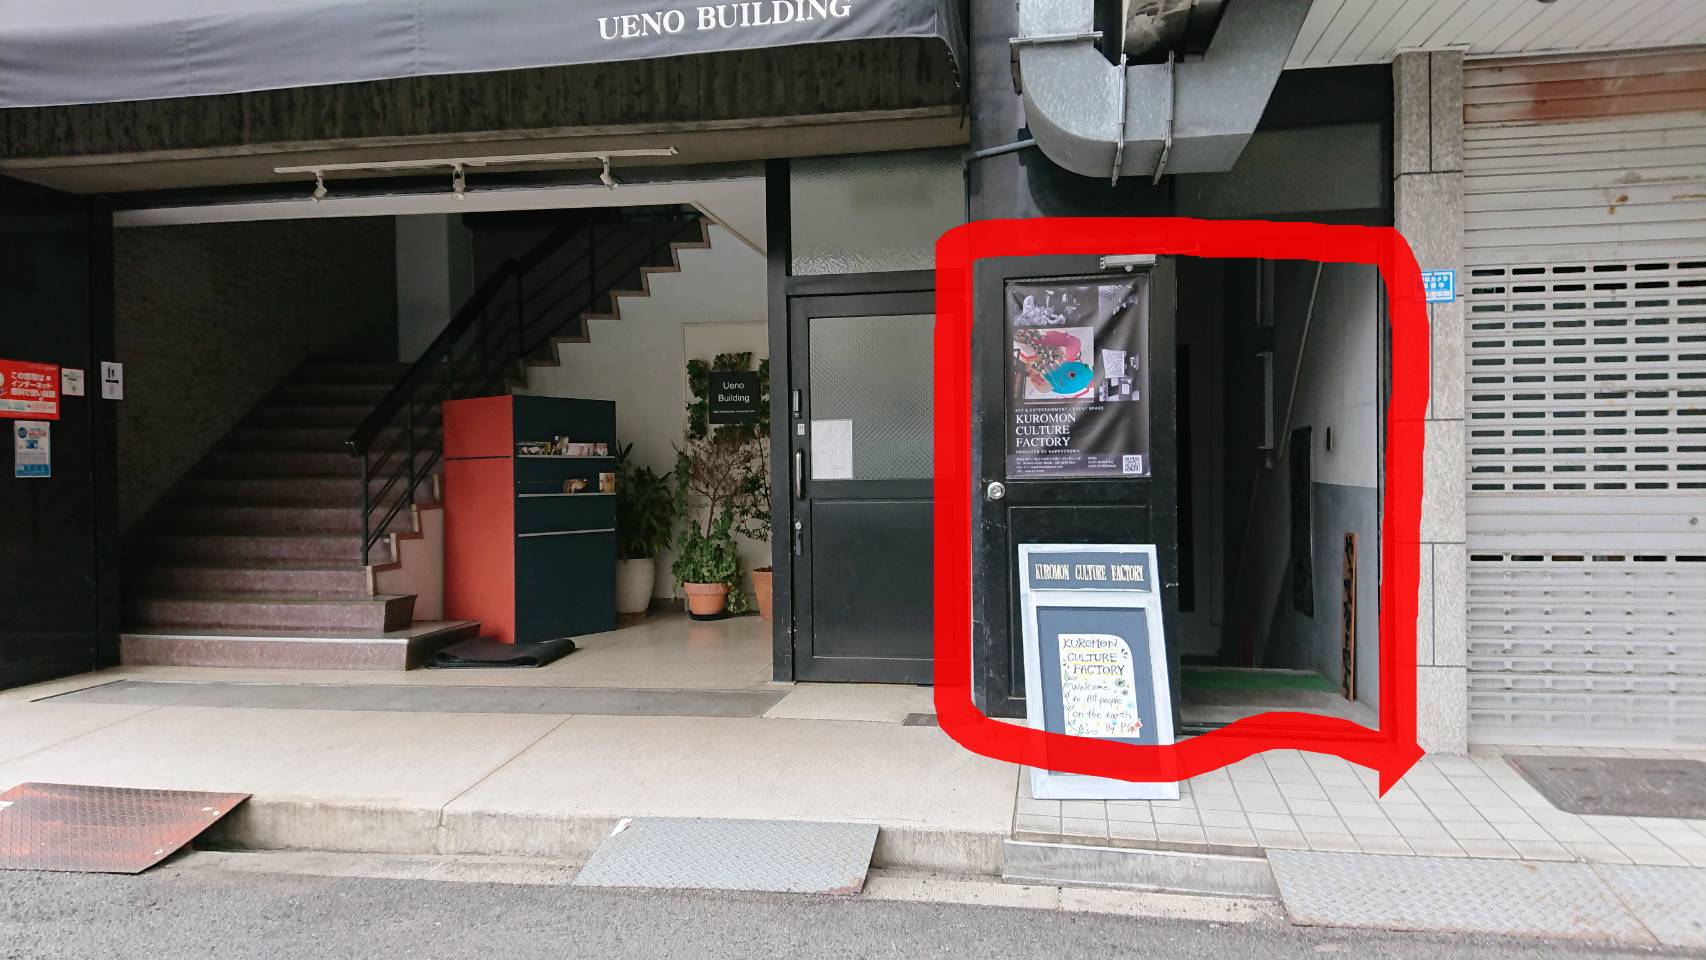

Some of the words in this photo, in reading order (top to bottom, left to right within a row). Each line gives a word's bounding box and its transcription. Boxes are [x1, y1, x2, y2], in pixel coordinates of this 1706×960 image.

[598, 10, 685, 39] UENO
[696, 0, 852, 30] BUILDING
[718, 394, 750, 403] Building
[1016, 413, 1076, 423] KUROMON
[1016, 425, 1070, 435] CULTURE
[1016, 437, 1070, 447] FACTORY
[1035, 563, 1070, 581] KUROMON
[1075, 564, 1107, 581] CULTURE
[1111, 564, 1145, 582] FACTORY
[1062, 637, 1118, 649] KUROMON
[1067, 652, 1118, 663] CULTURE
[1073, 664, 1125, 676] FACTORY
[1086, 708, 1101, 718] the
